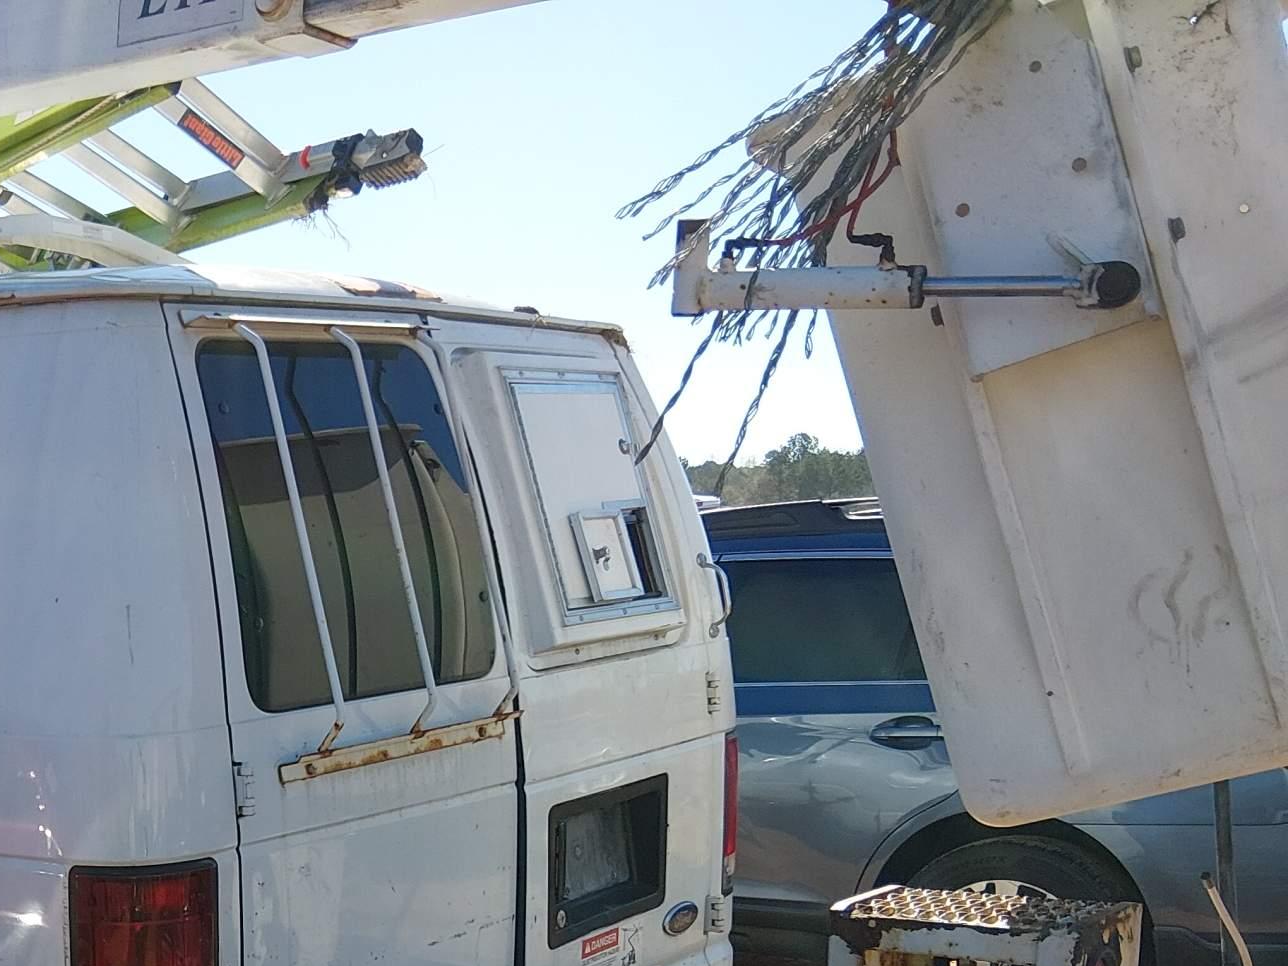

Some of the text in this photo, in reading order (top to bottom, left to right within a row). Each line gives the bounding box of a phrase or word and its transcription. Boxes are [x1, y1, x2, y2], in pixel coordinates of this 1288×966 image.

[181, 112, 244, 167] Little Giant
[591, 932, 617, 951] DANGER
